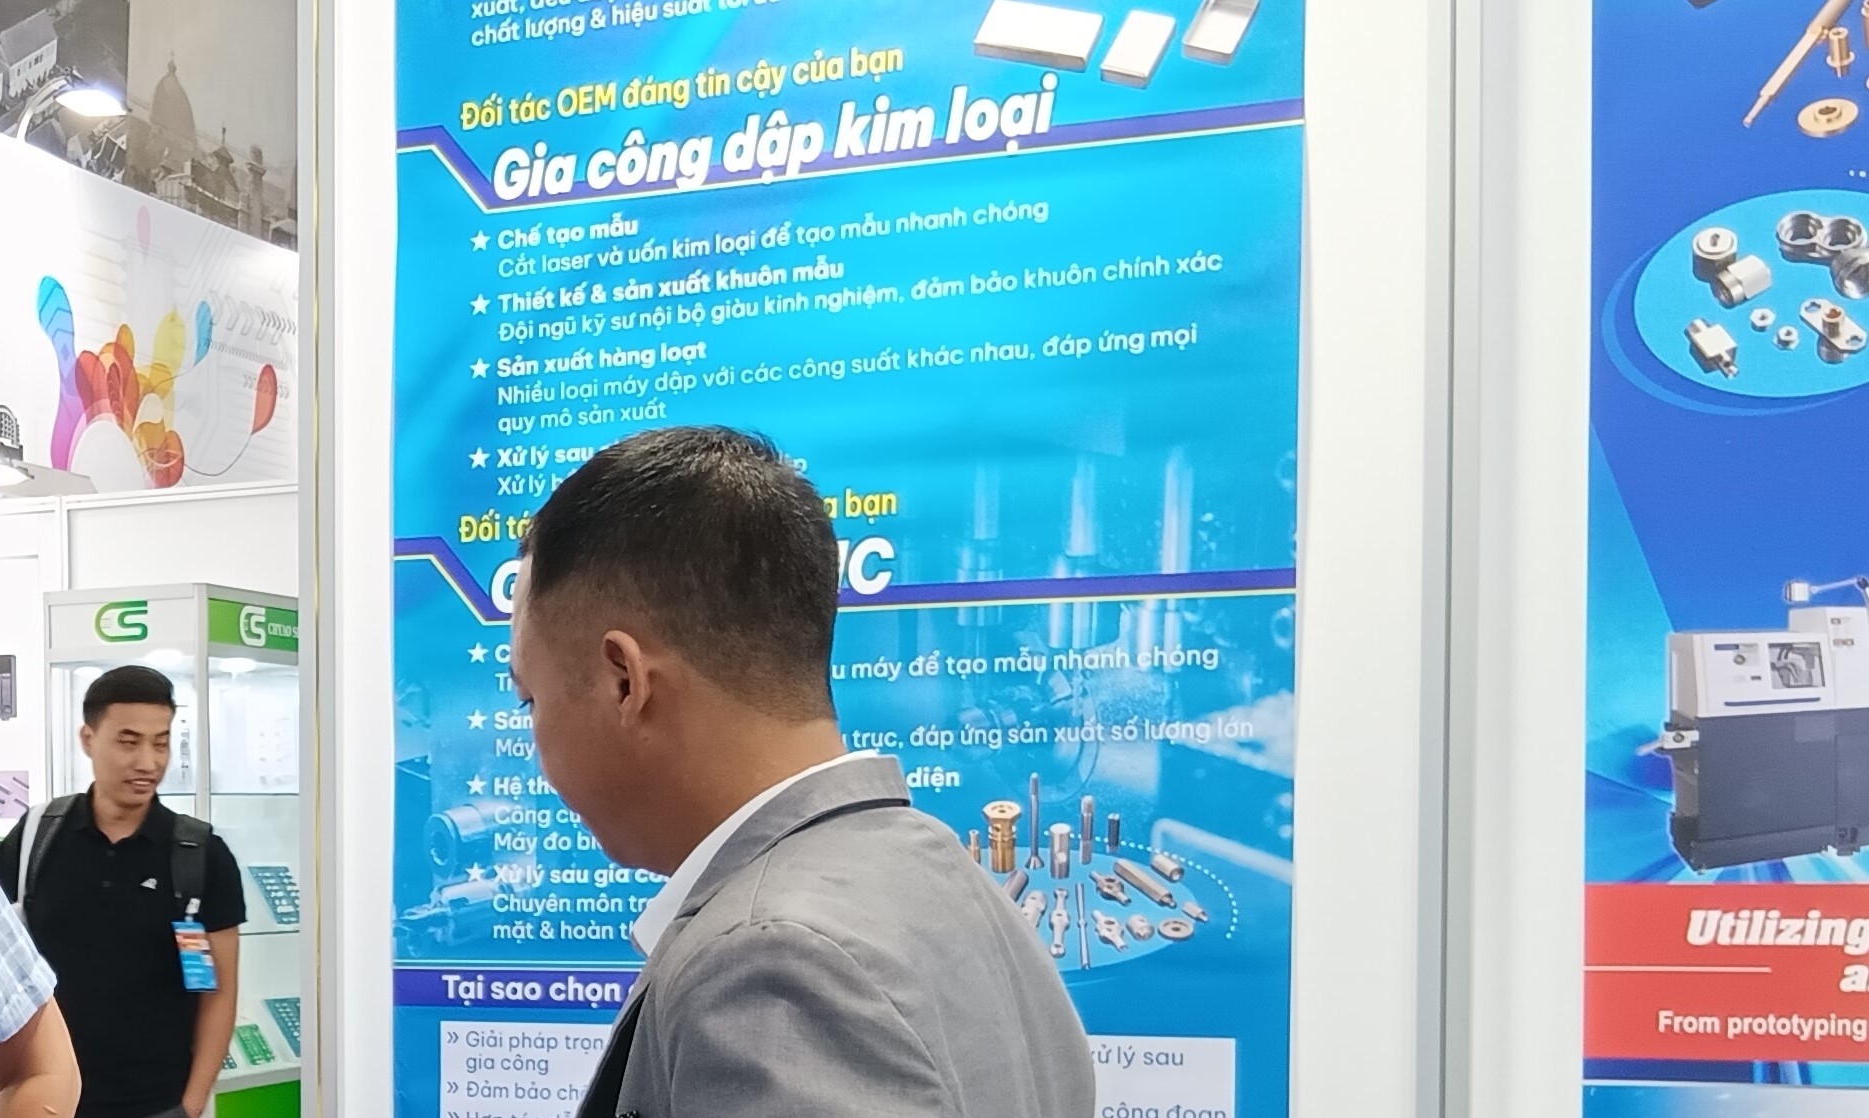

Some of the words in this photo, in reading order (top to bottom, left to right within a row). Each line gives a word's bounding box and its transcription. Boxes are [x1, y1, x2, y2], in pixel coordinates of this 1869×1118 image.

[460, 97, 503, 132] Đối
[509, 94, 552, 126] tác
[557, 83, 617, 118] OEM
[621, 76, 691, 112] đáng
[695, 68, 731, 101] tin
[736, 60, 787, 99] cậy
[792, 49, 844, 87] của
[850, 45, 903, 86] bạn
[493, 141, 575, 201] Gia
[587, 130, 713, 191] công
[723, 109, 825, 184] dập
[833, 94, 935, 160] kim
[945, 71, 1060, 153] loại
[497, 222, 542, 251] Chế
[547, 224, 586, 249] tạo
[590, 212, 639, 239] mẫu
[498, 250, 537, 279] Cắt
[541, 249, 593, 275] laser
[597, 244, 624, 267] và
[628, 237, 668, 265] uốn
[672, 234, 710, 259] kim
[715, 230, 756, 257] loại
[760, 222, 791, 250] để
[797, 223, 836, 247] tạo
[840, 212, 891, 240] mẫu
[895, 206, 968, 235] nhanh
[973, 200, 1049, 227] chóng
[497, 288, 556, 315] Thiết
[559, 283, 587, 309] kế
[590, 284, 607, 304] &
[613, 279, 653, 303] sản
[658, 269, 711, 298] xuất
[716, 263, 788, 292] khuôn
[793, 253, 845, 282] mẫu
[496, 354, 540, 378] Sản
[544, 346, 594, 374] xuất
[599, 344, 657, 369] hàng
[660, 341, 708, 364] loạt
[852, 654, 902, 683] máy
[908, 649, 940, 678] để
[946, 655, 988, 681] tạo
[993, 646, 1048, 675] mẫu
[1053, 645, 1132, 671] nhanh
[1137, 644, 1220, 674] chóng
[906, 767, 961, 793] diện
[492, 894, 572, 916] Chuyên
[576, 894, 624, 914] môn
[1686, 909, 1869, 955] Utilizing
[442, 975, 483, 1007] Tại
[490, 981, 542, 1001] sao
[549, 976, 621, 1009] chọn
[465, 1029, 504, 1048] Giải
[508, 1031, 559, 1052] pháp
[564, 1035, 604, 1055] trọn
[1658, 1010, 1721, 1033] From
[1727, 1011, 1867, 1041] prototyping
[465, 1054, 495, 1073] gia
[500, 1053, 550, 1075] công
[1117, 1045, 1136, 1069] lý
[1143, 1049, 1185, 1067] sau
